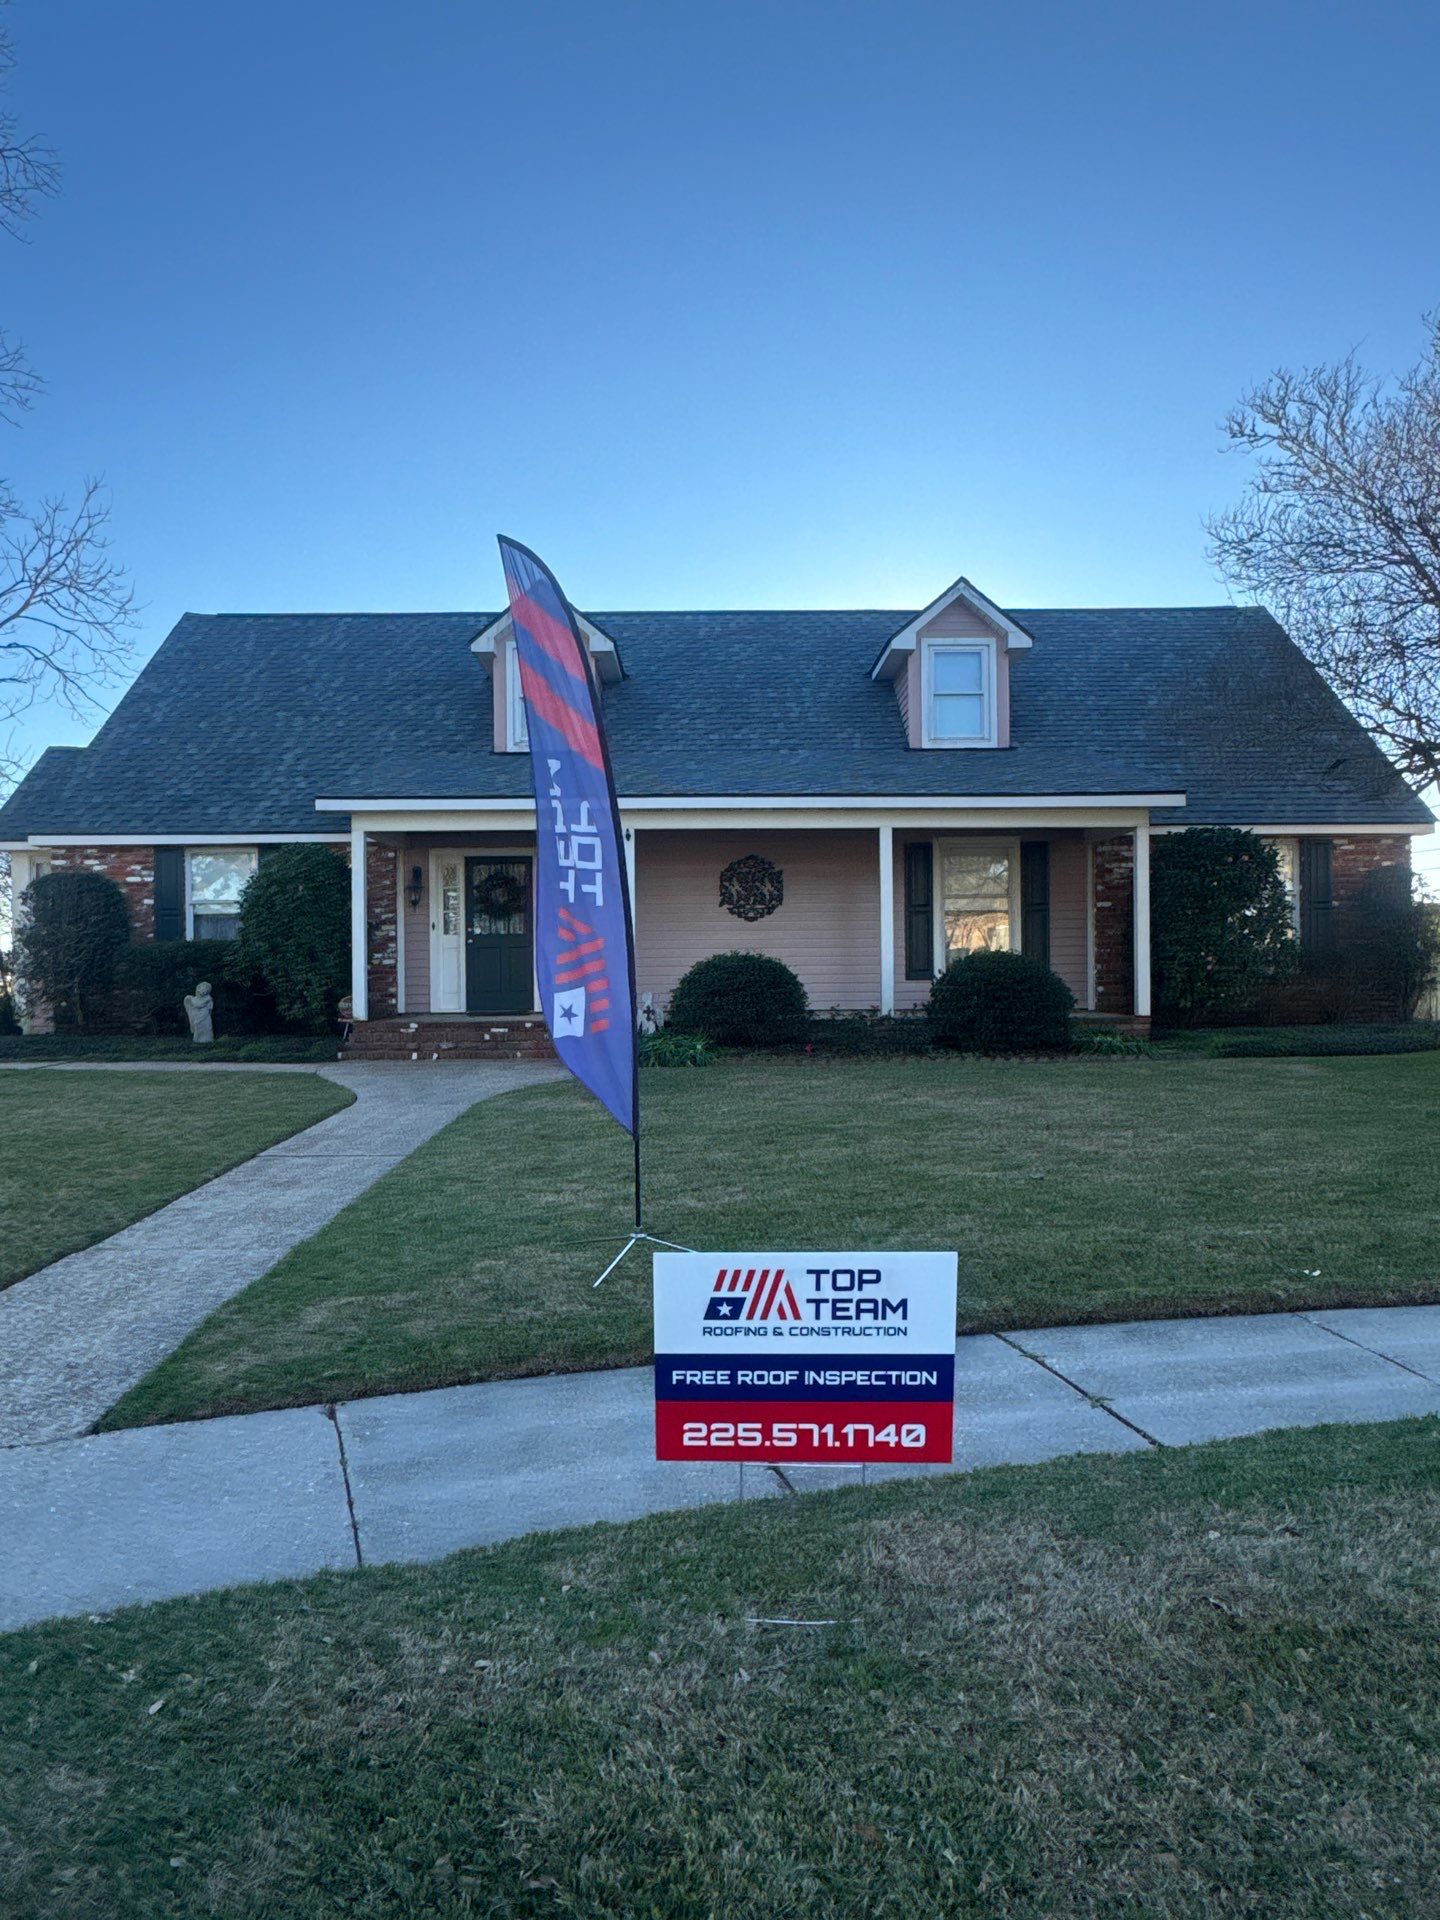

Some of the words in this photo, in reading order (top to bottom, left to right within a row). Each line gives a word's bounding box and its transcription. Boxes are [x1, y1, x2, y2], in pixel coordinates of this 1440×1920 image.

[806, 1269, 881, 1292] TOP
[806, 1298, 908, 1321] TEAM
[702, 1326, 768, 1337] ROOFING
[772, 1326, 784, 1337] &
[788, 1326, 908, 1337] CONSTRUCTION
[672, 1370, 731, 1385] FREE
[737, 1370, 799, 1385] ROOF
[804, 1370, 938, 1386] INSPECTION
[682, 1422, 926, 1448] 225.571.1740
